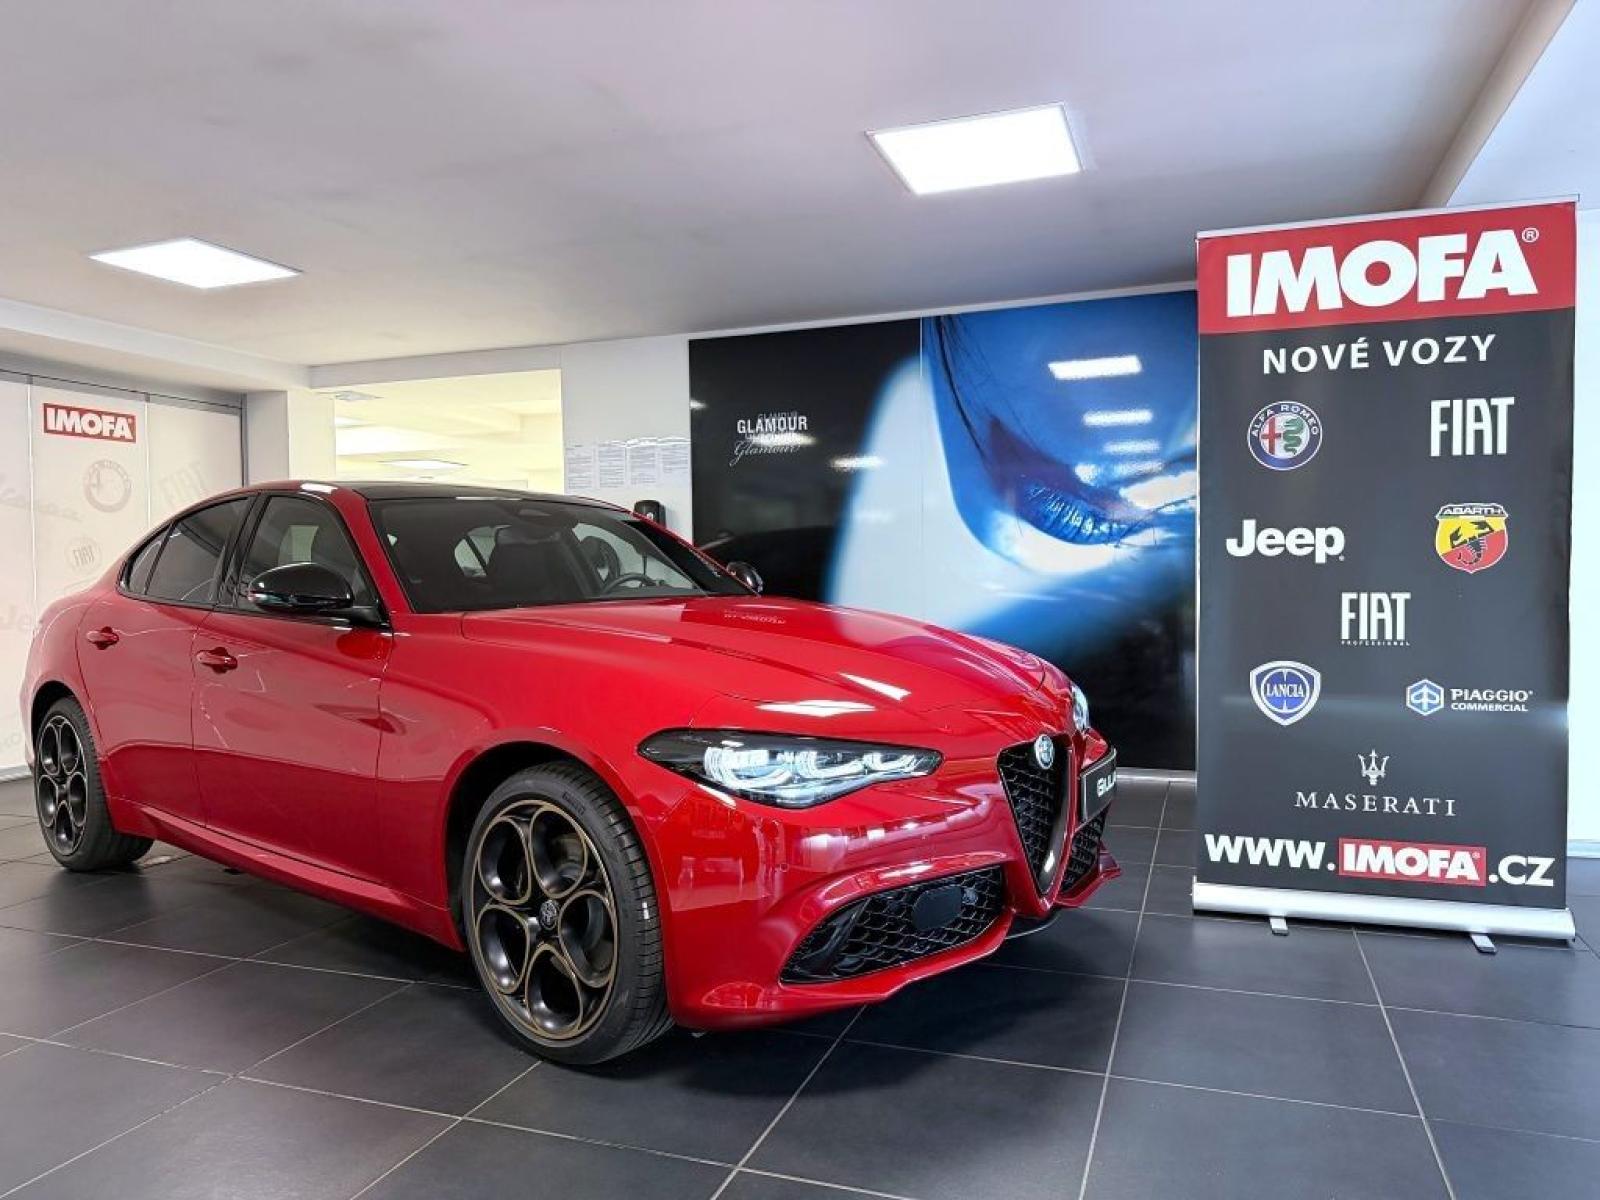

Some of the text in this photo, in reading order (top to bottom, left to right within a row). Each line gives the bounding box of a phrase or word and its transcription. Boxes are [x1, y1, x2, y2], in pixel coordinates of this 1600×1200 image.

[1263, 333, 1496, 375] NOVÉ VOZY
[737, 415, 809, 434] GLAMOUR
[1430, 396, 1515, 457] FIAT
[1442, 506, 1503, 515] ABARTH
[1226, 519, 1345, 563] Jeep
[1341, 591, 1412, 640] FIAT
[1266, 683, 1305, 698] LANCIA
[1449, 688, 1529, 702] PIAGGIO
[1451, 702, 1529, 712] COMMERCIAL
[1294, 791, 1456, 817] MASERATI
